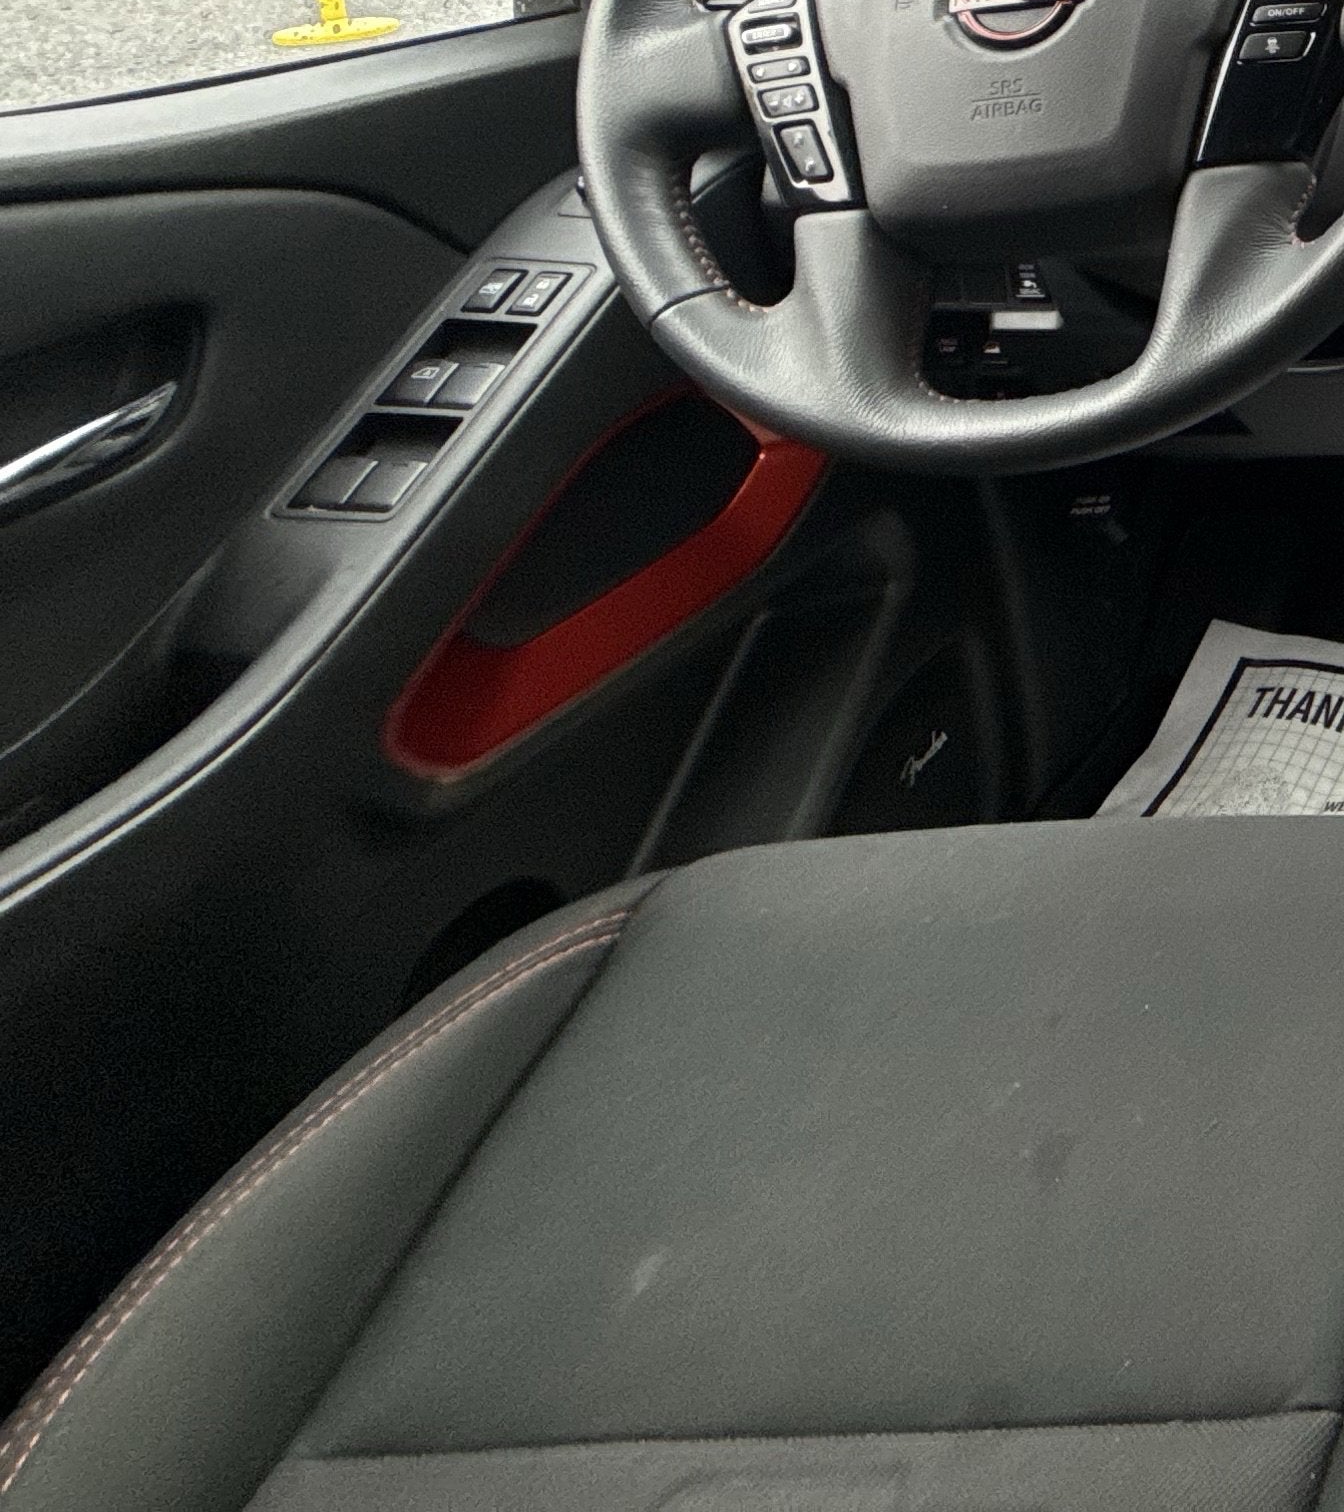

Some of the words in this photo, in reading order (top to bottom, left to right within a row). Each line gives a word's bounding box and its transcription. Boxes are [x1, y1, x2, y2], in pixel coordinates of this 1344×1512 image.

[1267, 7, 1305, 17] ON/OFF
[991, 78, 1024, 95] SRS
[971, 98, 1042, 121] AIRBAG
